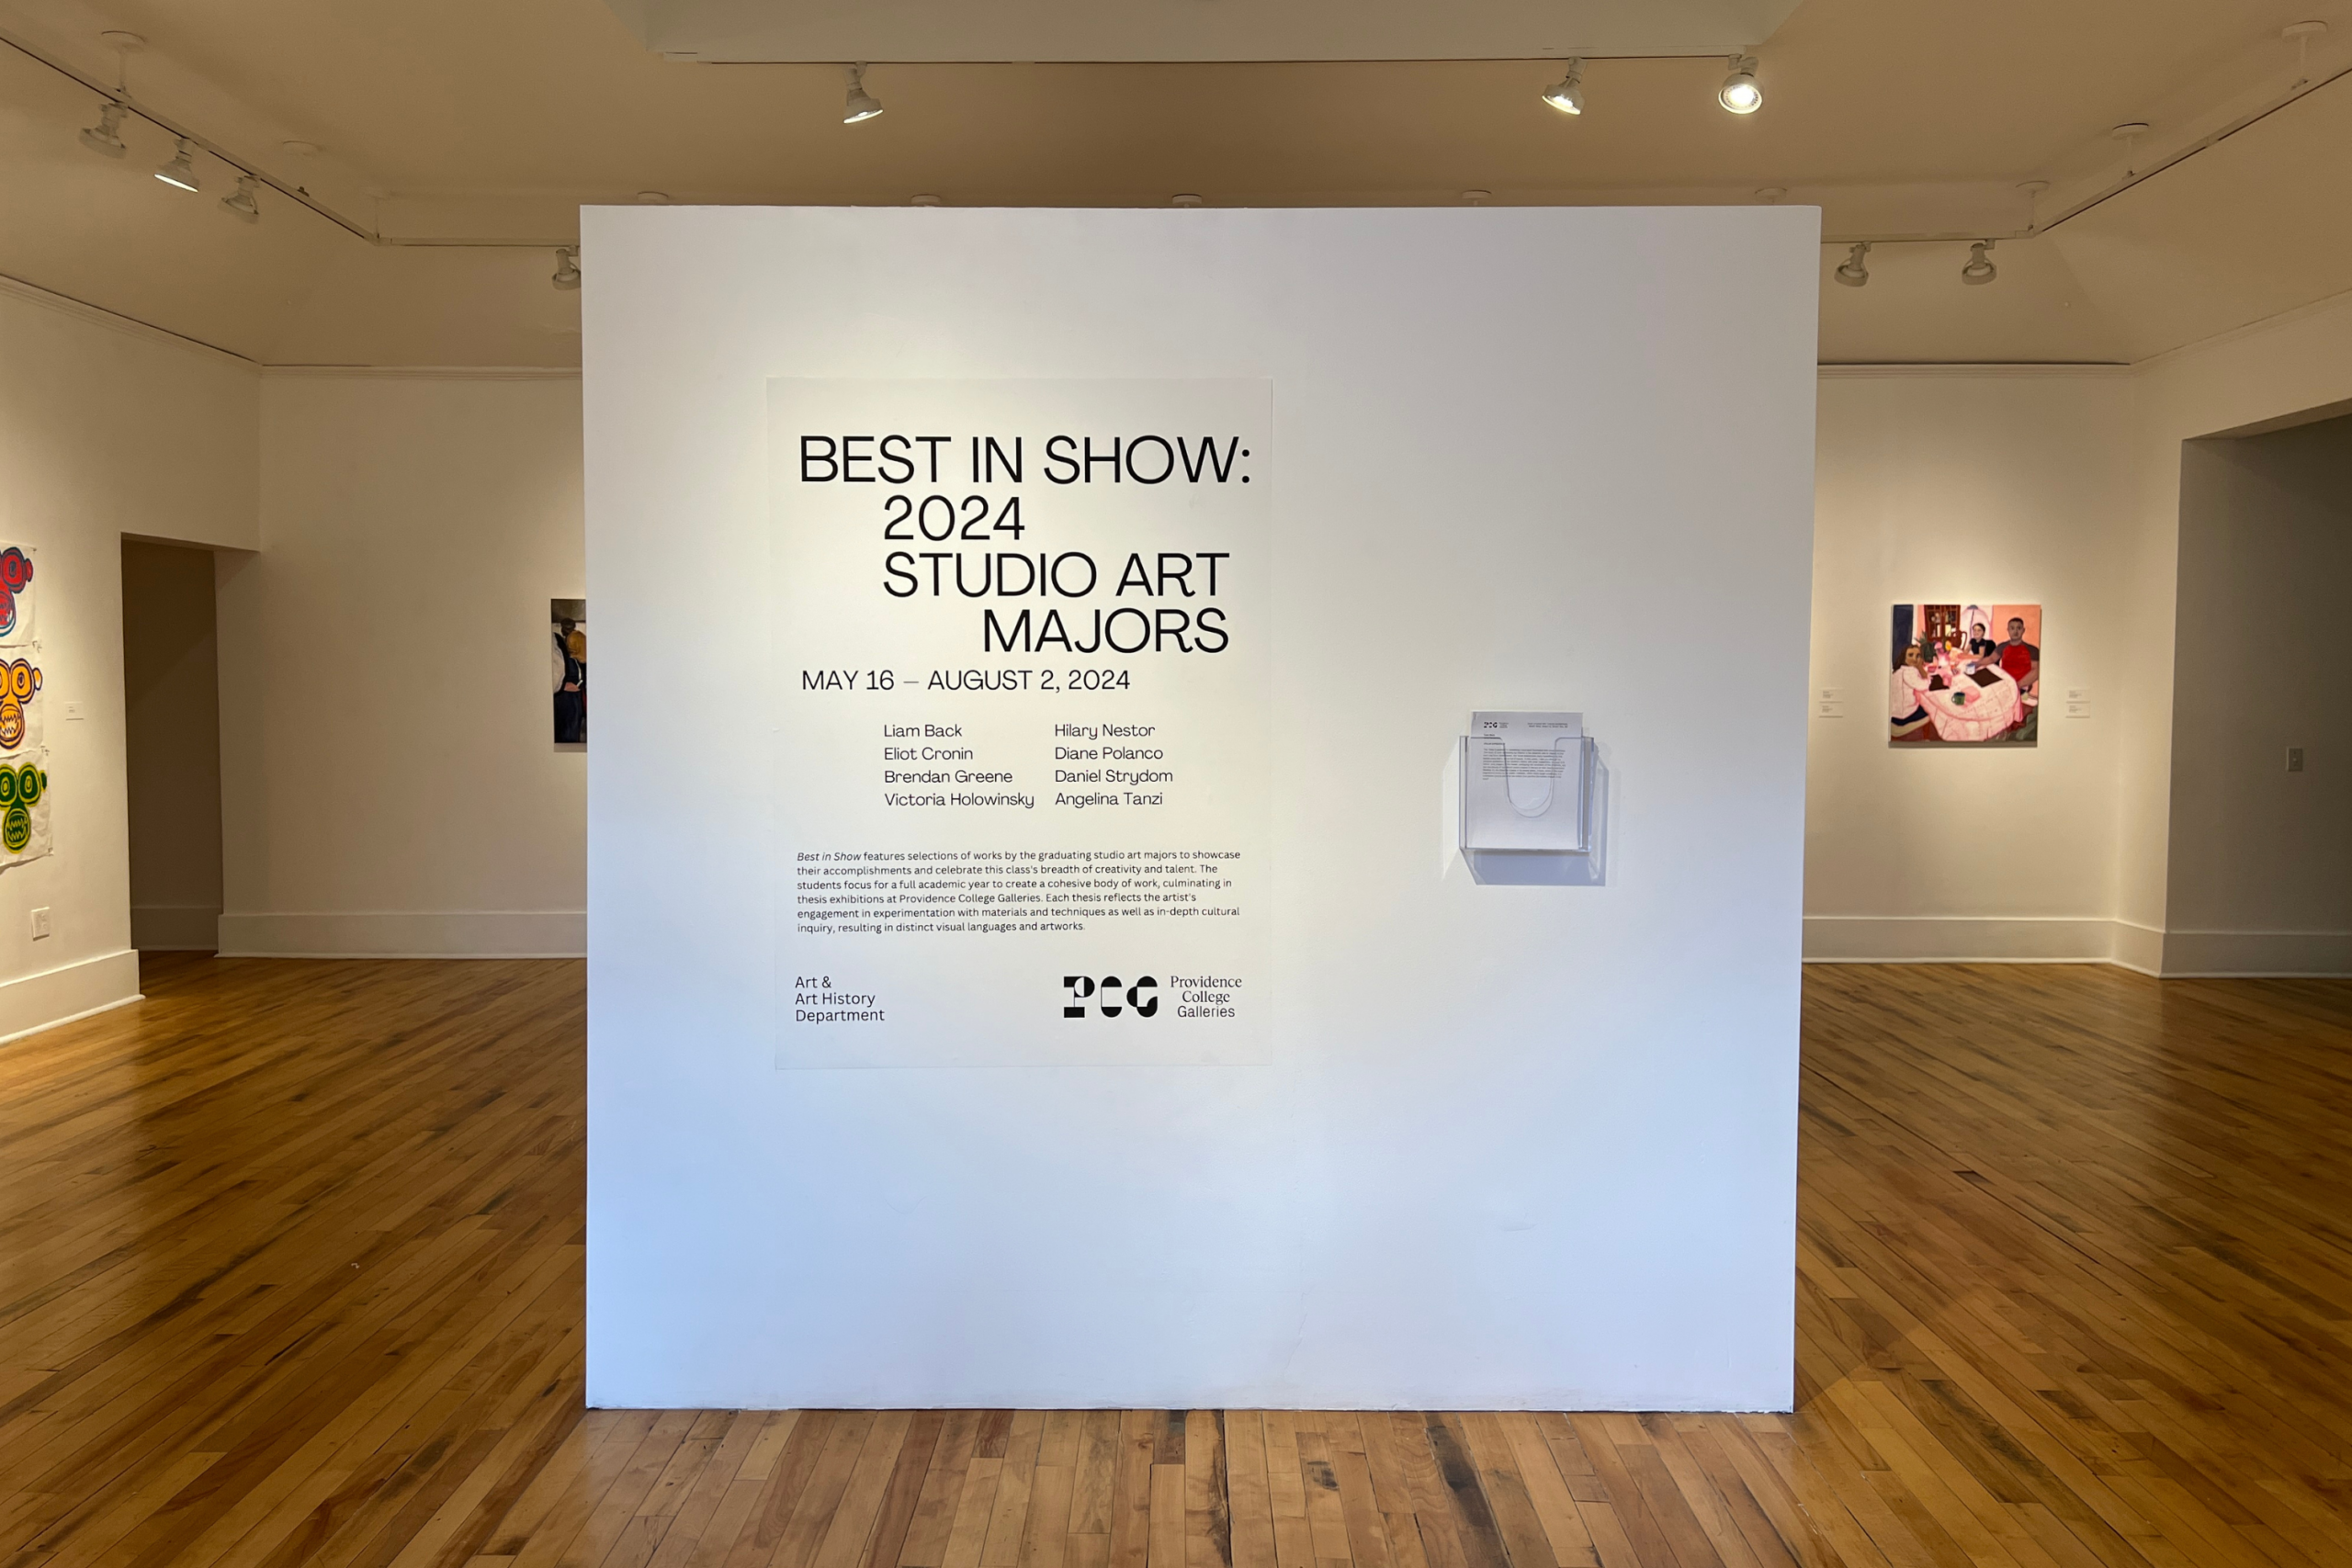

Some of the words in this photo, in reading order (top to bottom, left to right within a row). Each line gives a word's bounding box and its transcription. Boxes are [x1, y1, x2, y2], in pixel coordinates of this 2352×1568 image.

[800, 434, 952, 485] BEST
[972, 435, 1023, 484] IN
[1043, 434, 1250, 485] SHOW:
[884, 494, 1025, 542] 2024
[882, 550, 1098, 599] STUDIO
[1114, 552, 1230, 598] ART
[983, 606, 1229, 654] MAJORS
[801, 669, 860, 691] MAY
[865, 669, 895, 692] 16
[926, 669, 1034, 692] AUGUST
[1040, 669, 1061, 694] 2,
[1068, 669, 1131, 691] 2024
[884, 723, 921, 739] Liam
[924, 723, 963, 738] Back
[1054, 723, 1099, 741] Hilary
[1102, 723, 1156, 738] Nestor
[884, 746, 919, 761] Eliot
[921, 746, 974, 761] Cronin
[1055, 746, 1099, 761] Diane
[1102, 745, 1164, 761] Polanco
[884, 769, 951, 784] Brendan
[954, 769, 1013, 784] Greene
[1055, 768, 1102, 784] Daniel
[1104, 768, 1173, 786] Strydom
[884, 792, 947, 807] Victoria
[950, 791, 1035, 809] Holowinsky
[1054, 791, 1120, 809] Angelina
[1122, 791, 1163, 806] Tanzi
[797, 852, 820, 862] Best
[821, 852, 832, 862] in
[833, 852, 863, 862] Show
[863, 851, 906, 862] features
[907, 851, 959, 862] selections
[960, 850, 972, 861] of
[972, 850, 1003, 861] works
[1004, 851, 1018, 863] by
[1019, 850, 1037, 861] the
[1037, 850, 1092, 863] graduating
[1093, 850, 1125, 860] studio
[1126, 851, 1142, 860] art
[1143, 850, 1178, 863] majors
[1179, 851, 1191, 860] to
[1192, 850, 1241, 860] showcase
[796, 865, 822, 876] their
[822, 865, 912, 877] accomplishments
[913, 864, 933, 875] and
[934, 864, 983, 875] celebrate
[984, 864, 1004, 874] this
[1005, 864, 1039, 874] class's
[1040, 863, 1080, 874] breadth
[1081, 863, 1093, 874] of
[1094, 863, 1143, 876] creativity
[1143, 863, 1163, 874] and
[1164, 863, 1197, 874] talent.
[1199, 863, 1218, 874] The
[797, 880, 842, 891] students
[843, 879, 873, 890] focus
[873, 879, 890, 890] for
[890, 881, 898, 890] a
[899, 879, 917, 890] full
[918, 879, 967, 889] academic
[967, 880, 991, 891] year
[991, 880, 1004, 889] to
[1004, 879, 1038, 889] create
[1038, 880, 1046, 888] a
[1046, 878, 1092, 888] cohesive
[1093, 878, 1120, 891] body
[1121, 877, 1133, 888] of
[1133, 877, 1161, 890] work,
[1162, 877, 1222, 890] culminating
[1223, 877, 1232, 888] in
[797, 894, 828, 905] thesis
[829, 894, 885, 905] exhibitions
[886, 895, 898, 904] at
[899, 893, 956, 904] Providence
[957, 893, 996, 906] College
[997, 893, 1044, 903] Galleries.
[1046, 892, 1070, 903] Each
[1071, 892, 1102, 903] thesis
[1103, 892, 1142, 903] reflects
[1143, 892, 1161, 903] the
[1161, 892, 1197, 903] artist's
[797, 909, 860, 921] engagement
[861, 908, 872, 919] in
[873, 908, 956, 920] experimentation
[956, 908, 979, 918] with
[981, 907, 1028, 918] materials
[1029, 907, 1049, 917] and
[1050, 907, 1106, 919] techniques
[1107, 908, 1120, 917] as
[1121, 906, 1142, 917] well
[1143, 908, 1155, 917] as
[1157, 906, 1200, 919] in-depth
[1201, 906, 1240, 917] cultural
[797, 922, 836, 935] inquiry,
[837, 922, 883, 935] resulting
[884, 922, 894, 932] in
[895, 921, 934, 932] distinct
[935, 921, 966, 932] visual
[967, 921, 1017, 934] languages
[1018, 920, 1038, 931] and
[1039, 920, 1086, 931] artworks.
[794, 976, 819, 989] Art
[820, 975, 832, 989] &
[1170, 975, 1243, 988] Providence
[794, 992, 819, 1006] Art
[821, 991, 876, 1009] History
[1062, 975, 1159, 1019] PCG
[1182, 989, 1231, 1006] College
[796, 1009, 886, 1026] Department
[1177, 1005, 1236, 1019] Galleries
